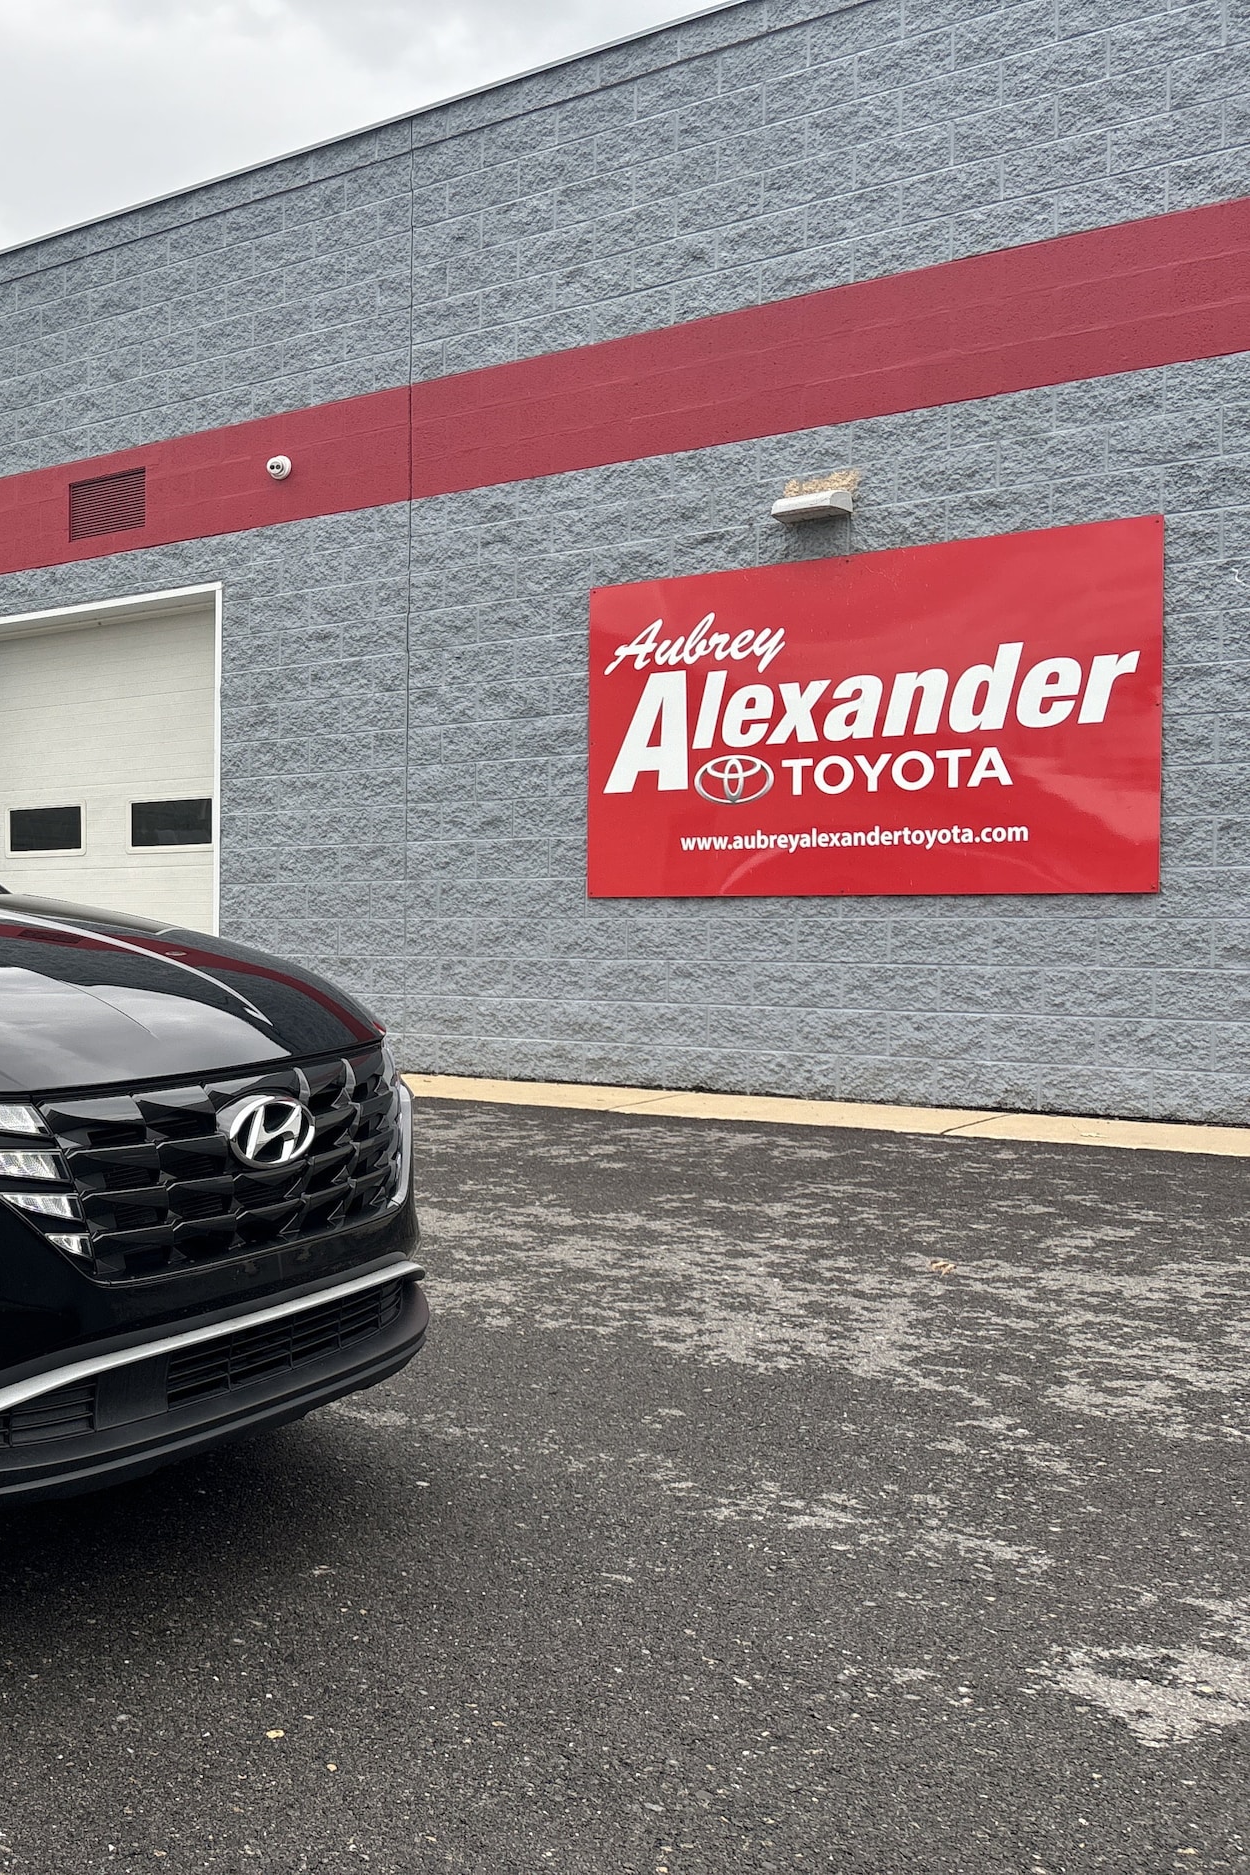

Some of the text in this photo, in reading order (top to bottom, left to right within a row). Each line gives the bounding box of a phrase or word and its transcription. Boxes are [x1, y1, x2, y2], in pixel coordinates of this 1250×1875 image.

[604, 612, 786, 675] Aubrey
[603, 641, 1141, 794] Alexander
[781, 746, 1014, 796] TOYOTA
[680, 825, 1030, 854] www.aubreyalexandertoyota.com
